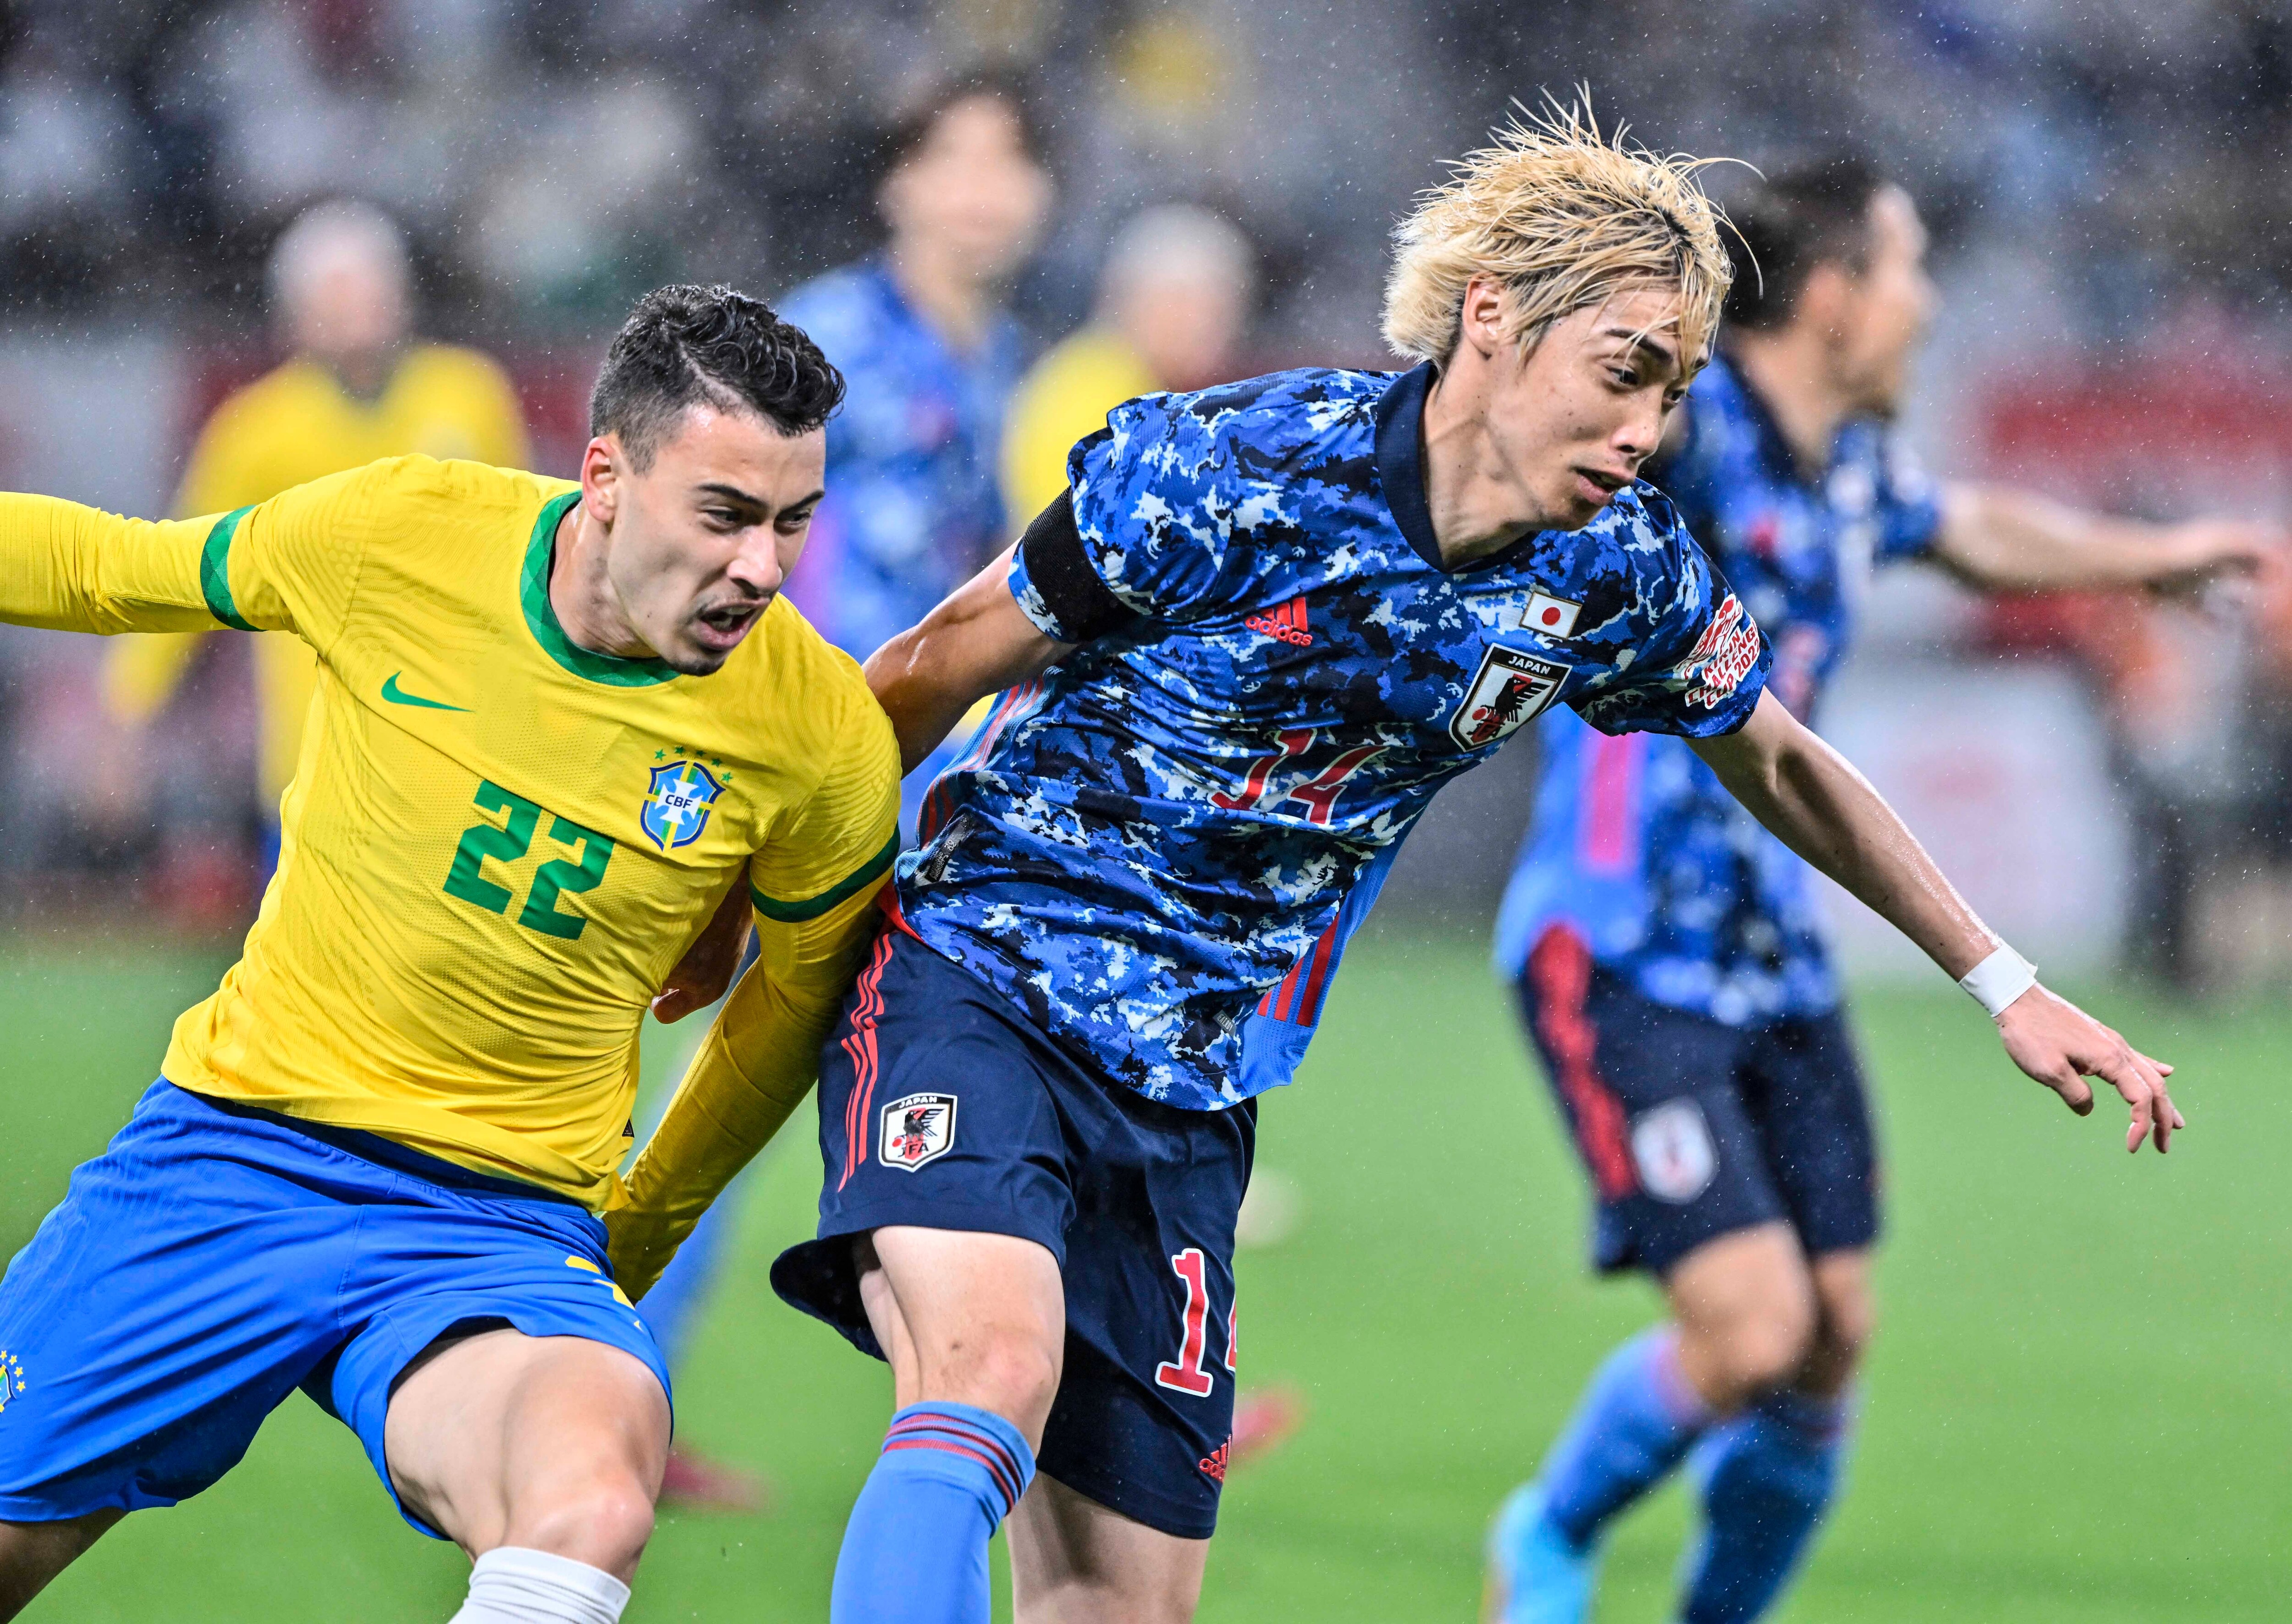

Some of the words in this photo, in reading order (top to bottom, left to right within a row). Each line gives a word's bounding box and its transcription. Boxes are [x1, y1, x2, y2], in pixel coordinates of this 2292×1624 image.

[1245, 616, 1313, 647] adidas
[1508, 655, 1551, 675] JAPAN
[1704, 630, 1741, 680] KIRIN
[1707, 673, 1734, 706] CUP
[1207, 728, 1391, 826] 14
[665, 794, 693, 809] CBF
[442, 779, 617, 941] 22
[898, 1096, 937, 1109] JAPAN
[898, 1142, 929, 1158] JFA
